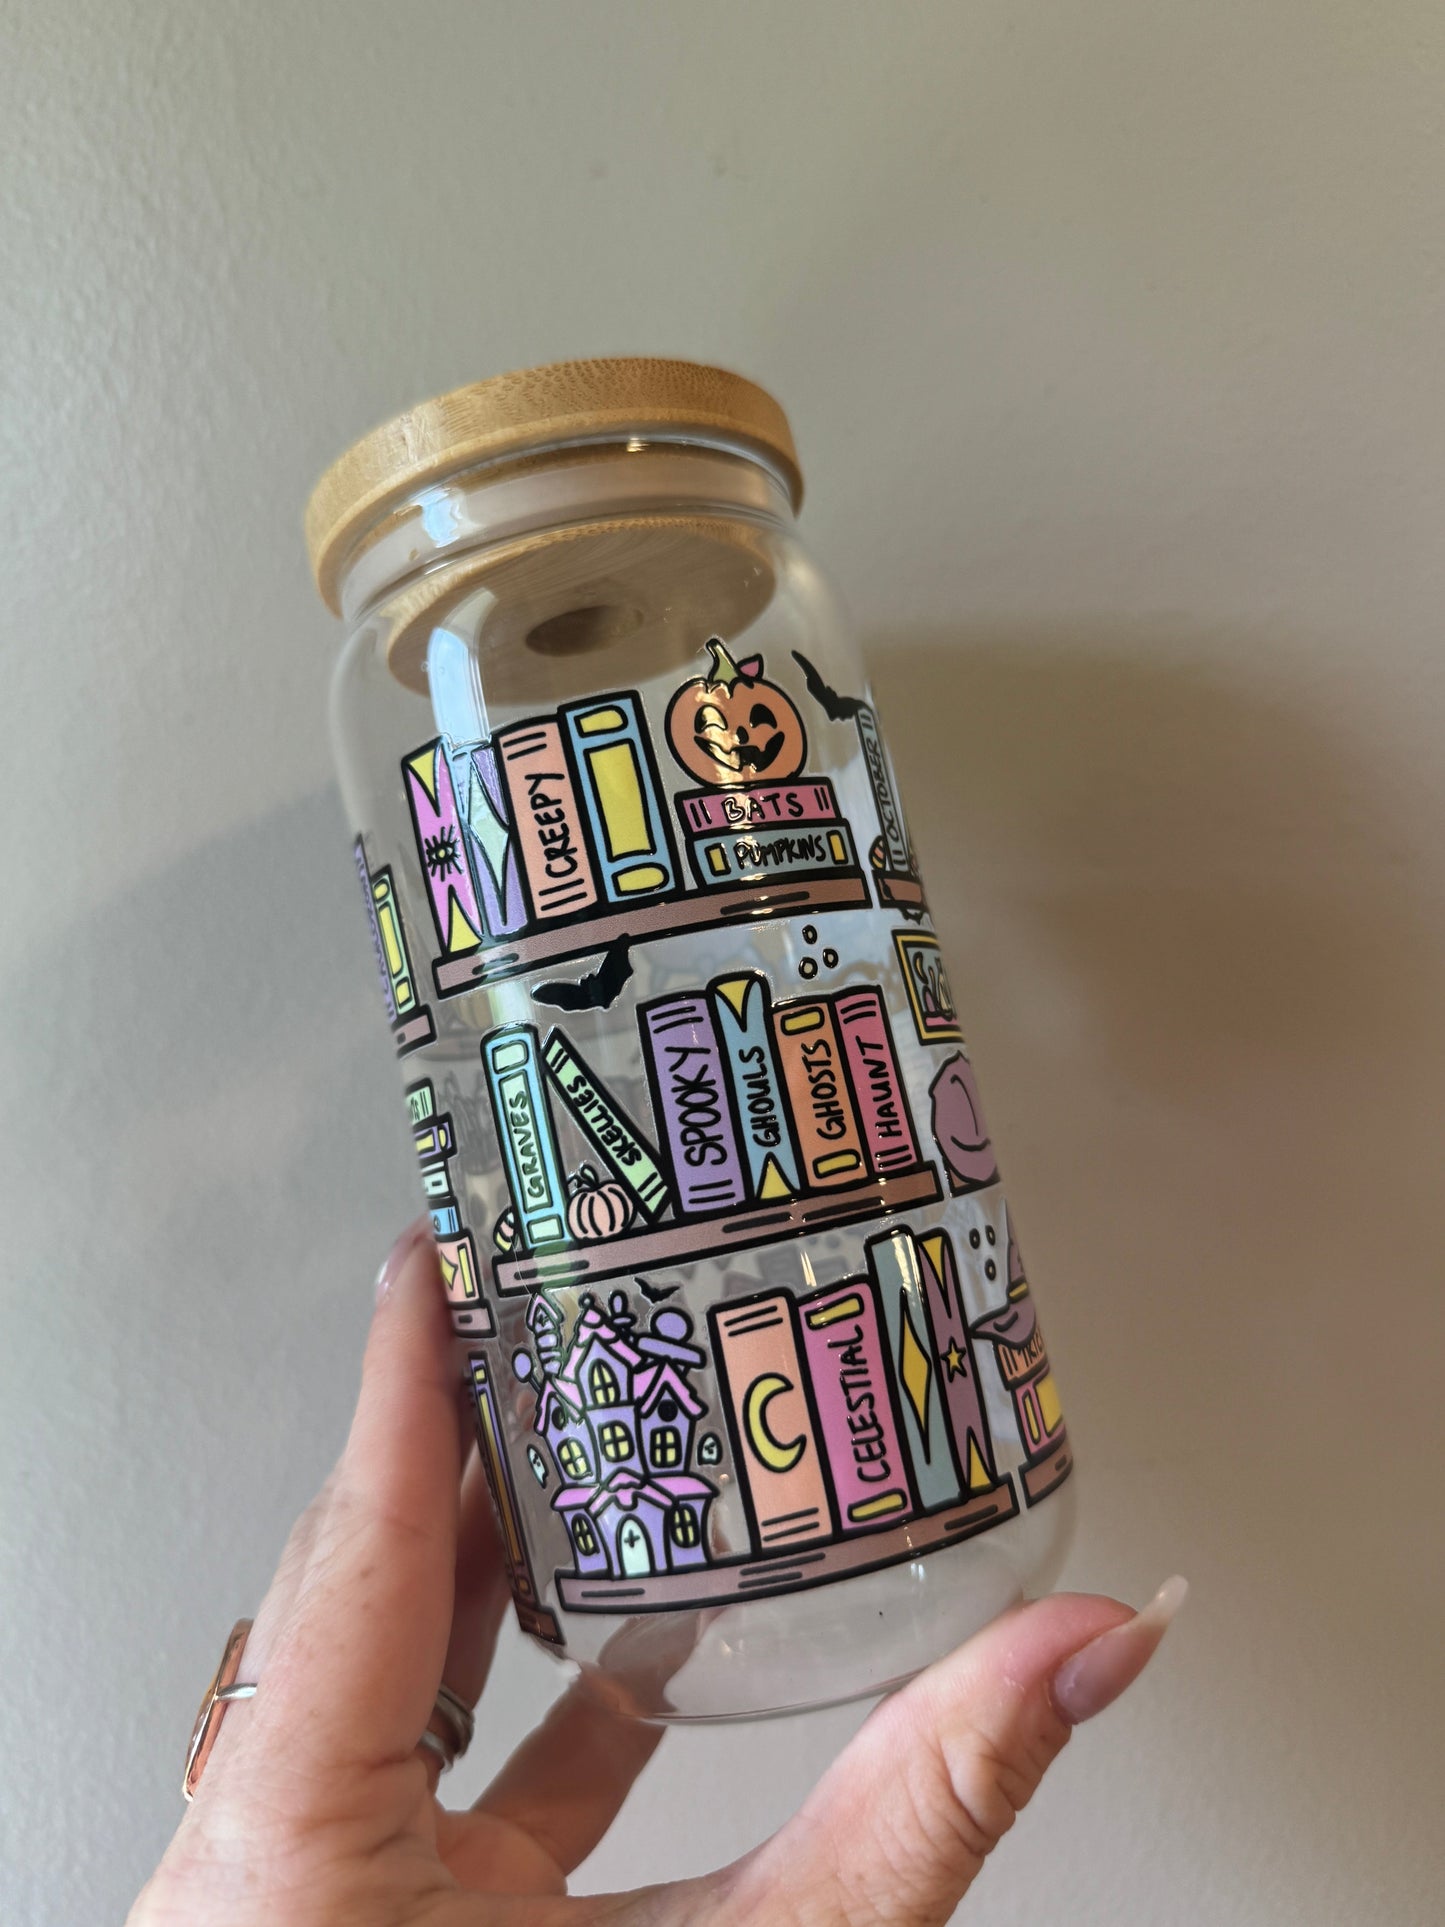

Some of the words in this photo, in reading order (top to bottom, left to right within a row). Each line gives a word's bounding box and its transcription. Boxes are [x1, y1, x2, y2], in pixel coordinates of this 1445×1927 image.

[524, 773, 578, 878] CREEPY
[721, 792, 804, 824] BATS
[866, 737, 900, 843] OCTOBER
[733, 834, 827, 869] PUMPKINS
[566, 1075, 643, 1166] SKELLIES
[665, 1046, 728, 1166] SPOOKY
[738, 1046, 781, 1147] GHOULS
[801, 1039, 847, 1139] GHOSTS
[855, 1035, 902, 1137] HAUNT
[508, 1090, 545, 1198] GRAVES
[827, 1324, 891, 1482] CELESTIAL
